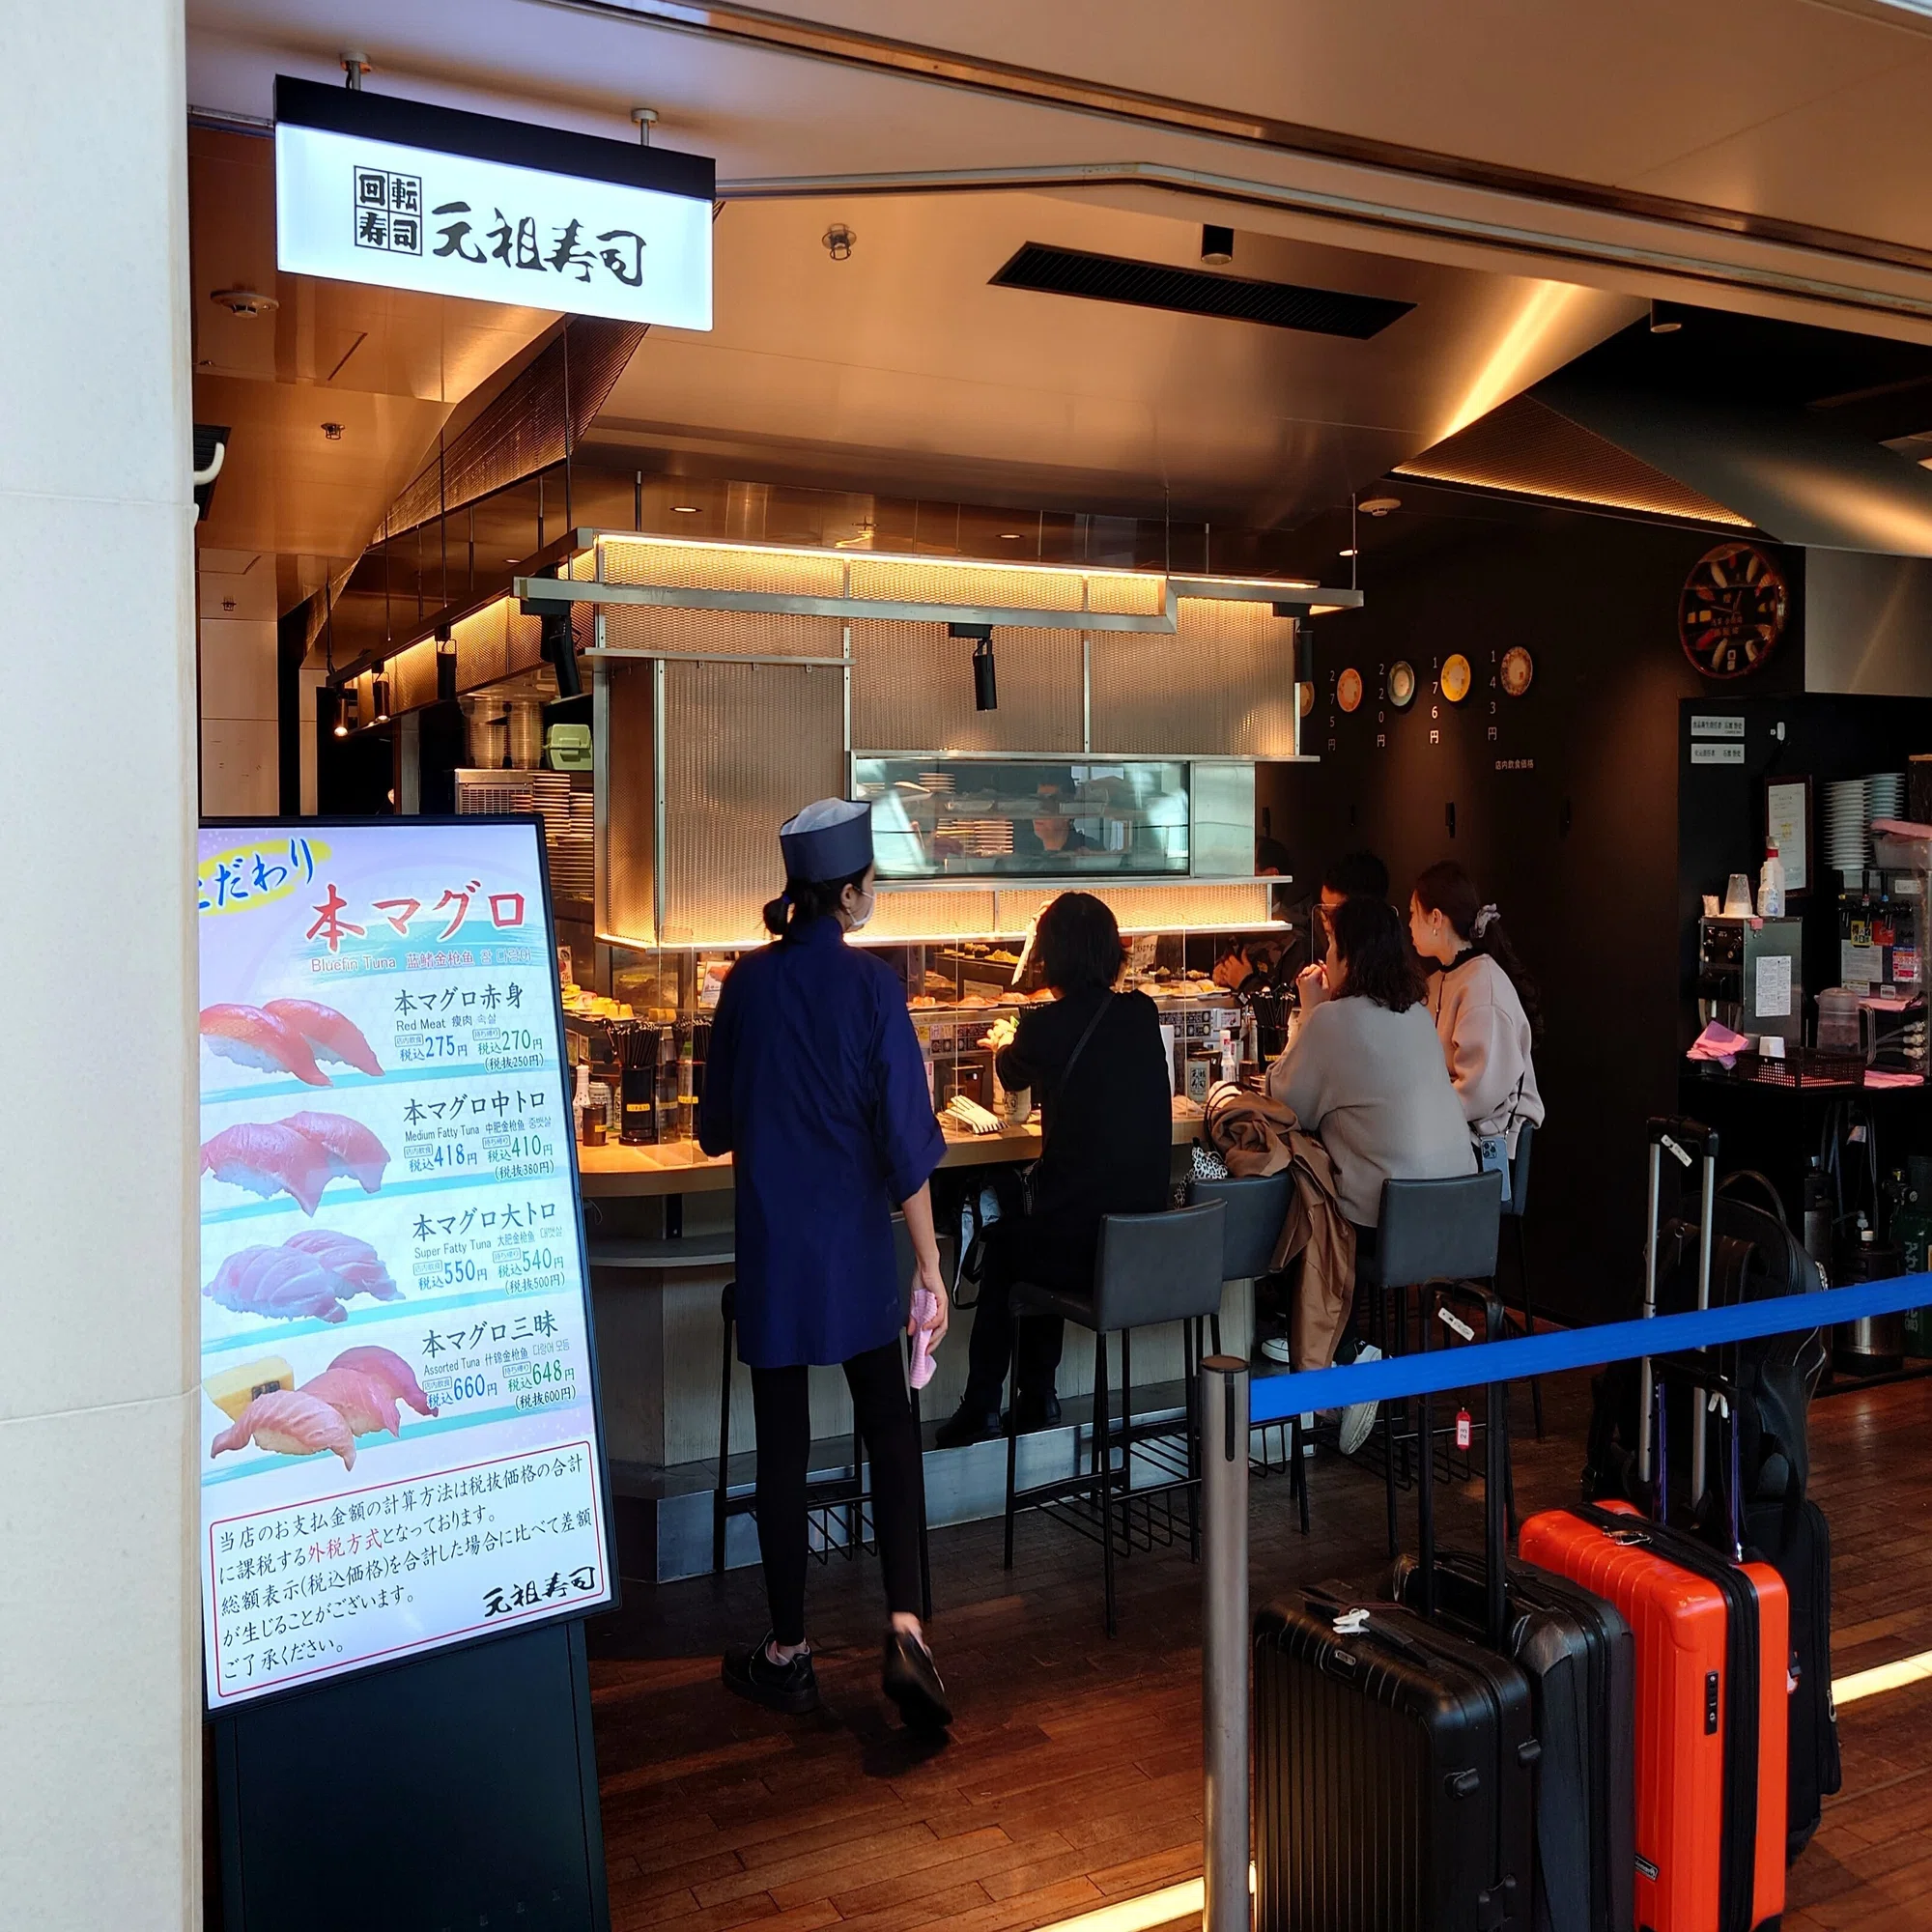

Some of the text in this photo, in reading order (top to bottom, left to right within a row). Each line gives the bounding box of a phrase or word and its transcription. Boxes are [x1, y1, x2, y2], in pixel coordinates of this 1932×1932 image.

[432, 201, 646, 288] 元祖寿司
[1327, 670, 1336, 752] 275円
[1377, 664, 1385, 748] 220円
[1430, 657, 1439, 744] 176円
[1488, 650, 1497, 741] 143円
[1495, 759, 1534, 770] 店内飲食価格
[306, 880, 526, 952] 本マグロ
[311, 957, 358, 972] Bluefin
[363, 956, 396, 970] Tuna
[394, 981, 523, 1016] 本マグロ赤身
[396, 1020, 417, 1032] Red
[420, 1018, 446, 1030] Meat
[485, 1053, 544, 1071] (税抜250円)
[404, 1090, 545, 1126] 本マグロ中トロ
[406, 1128, 435, 1142] Medium
[437, 1126, 458, 1139] Fatty
[460, 1124, 479, 1135] Tuna
[495, 1161, 554, 1180] (税抜380円)
[412, 1202, 555, 1242] 本マグロ大トロ
[414, 1247, 440, 1261] Super
[443, 1243, 468, 1255] Fatty
[469, 1239, 492, 1250] Tuna
[505, 1272, 565, 1294] (税抜500円)
[422, 1310, 558, 1359] 本マグロ三昧
[424, 1359, 459, 1377] Assorted
[461, 1357, 480, 1369] Tuna
[515, 1385, 577, 1410] (税抜600円)
[1460, 1429, 1467, 1438] 23
[220, 1453, 582, 1552] 当店のお支払金額の計算方法は税抜価格の合計
[221, 1508, 591, 1616] 総額表示(税込価格)を合計した場合に比べて差額
[483, 1566, 596, 1618] 元祖寿司
[223, 1584, 413, 1647] が生じることがございます。
[224, 1639, 344, 1679] ご了承ください。
